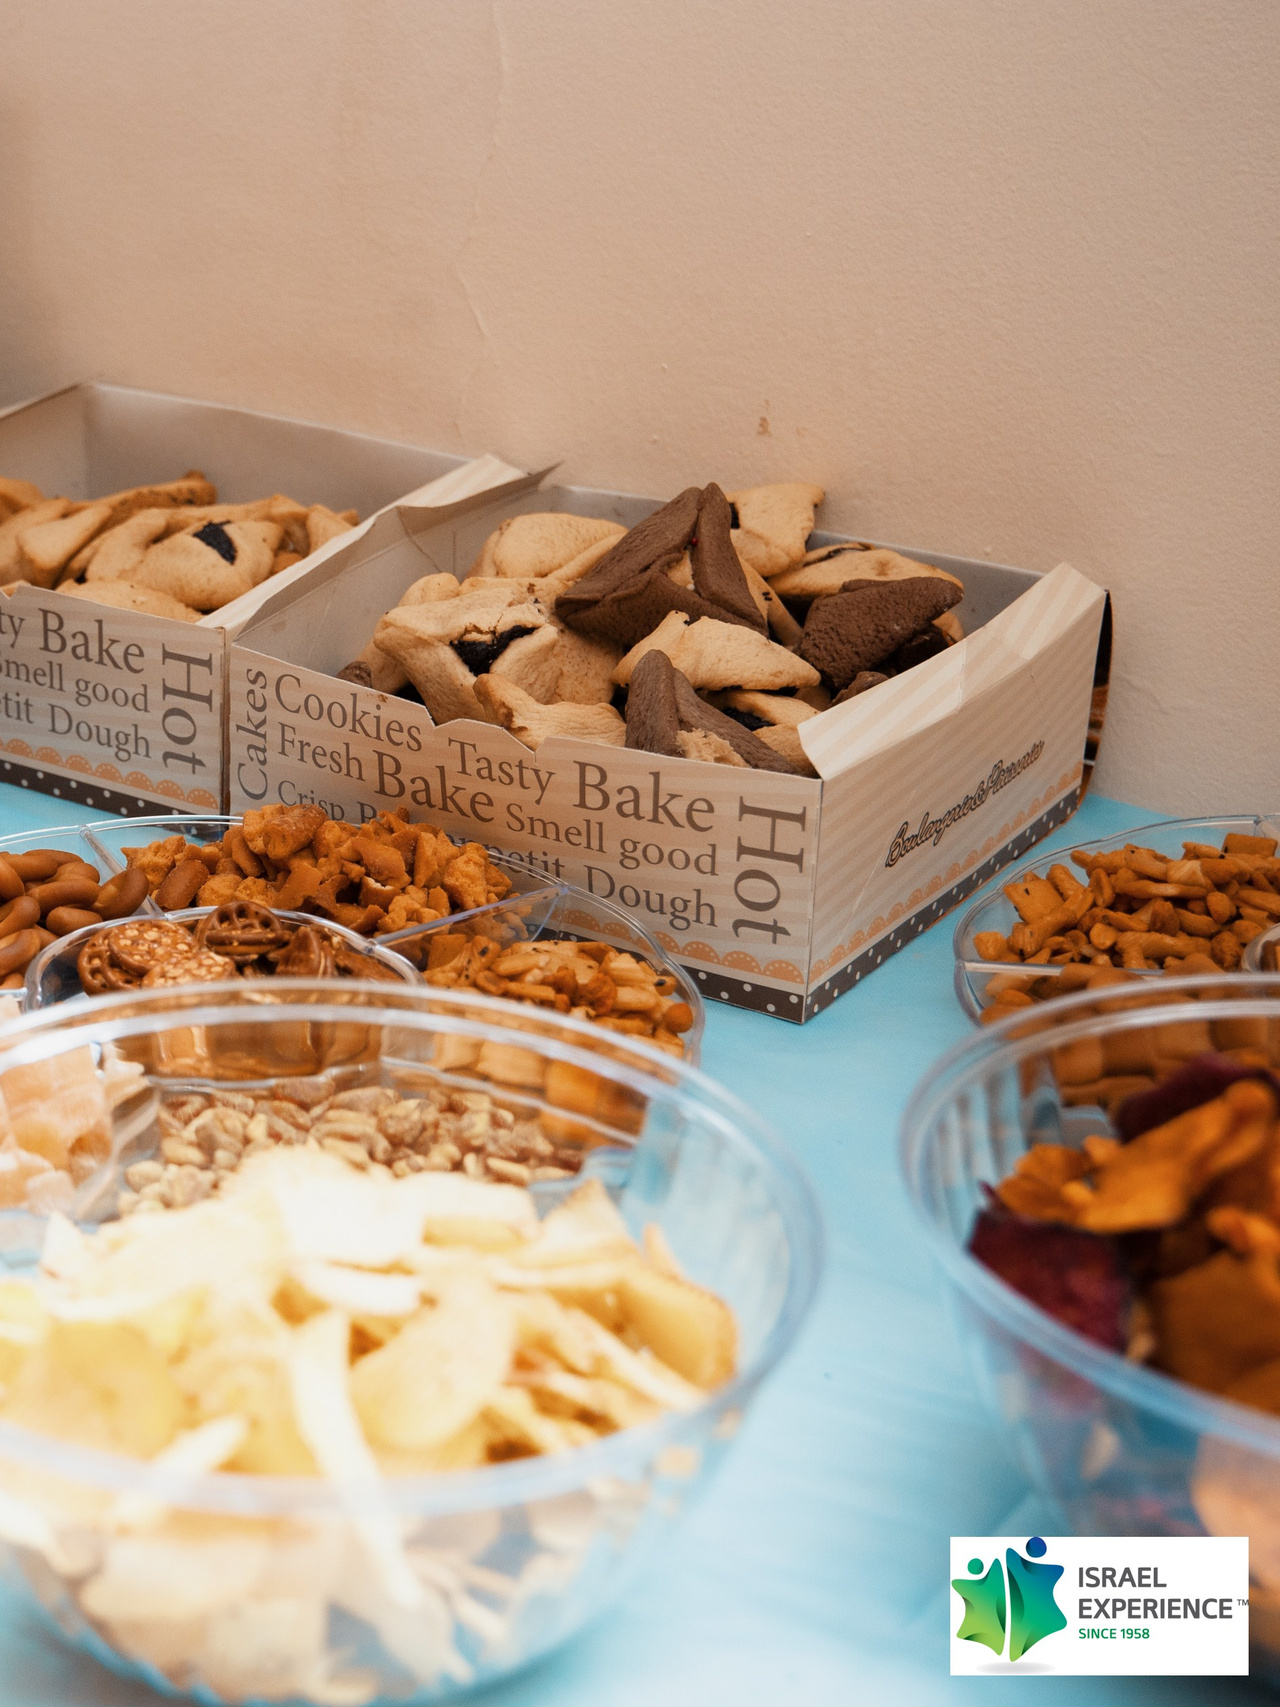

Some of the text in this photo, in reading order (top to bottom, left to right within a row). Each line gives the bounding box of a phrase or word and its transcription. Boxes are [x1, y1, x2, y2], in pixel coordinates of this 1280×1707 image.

[38, 608, 145, 675] Bake
[75, 678, 151, 714] good
[48, 703, 152, 763] Dough
[162, 643, 213, 775] Hot
[235, 668, 269, 800] Cakes
[275, 673, 715, 833] Cookies Tasty Bake
[278, 722, 719, 876] Fresh Bake Smell good
[583, 864, 718, 931] Dough
[732, 795, 807, 945] Hot
